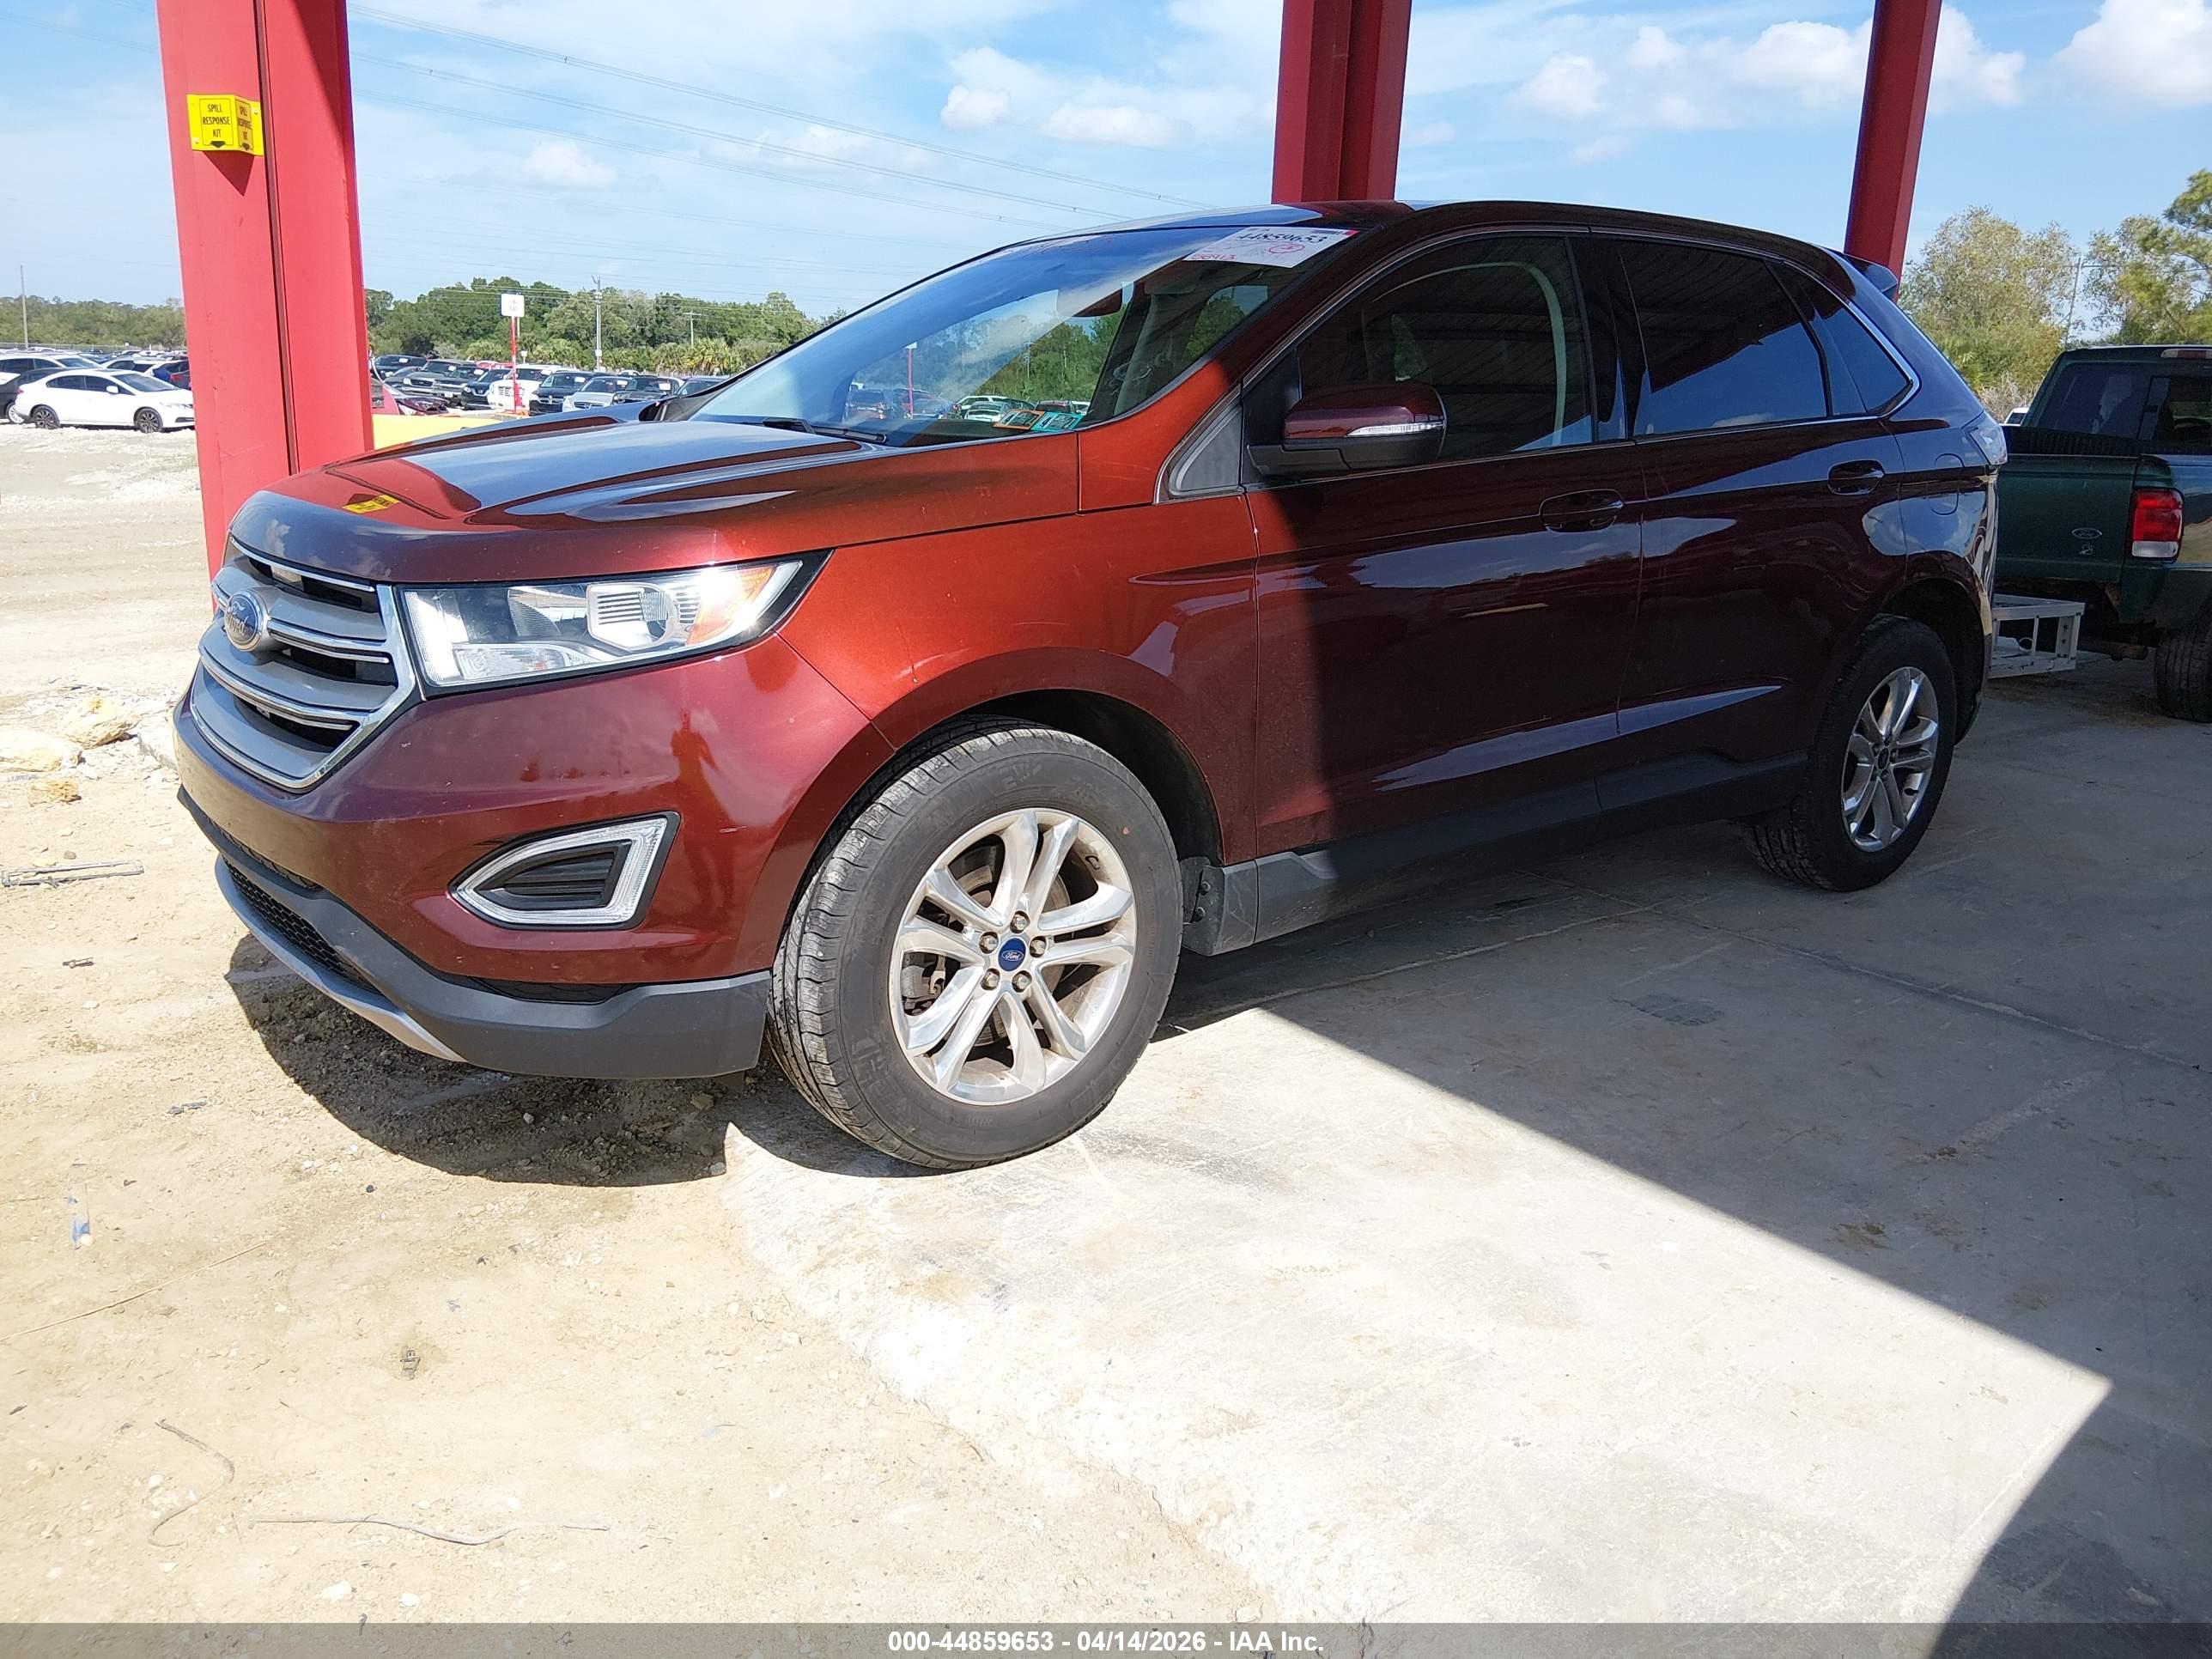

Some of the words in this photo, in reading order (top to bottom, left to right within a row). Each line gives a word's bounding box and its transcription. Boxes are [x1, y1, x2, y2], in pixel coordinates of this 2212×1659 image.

[207, 104, 223, 112] SPILL
[202, 117, 231, 125] RESPONSE
[212, 129, 222, 137] KIT
[1236, 233, 1328, 244] 44859653
